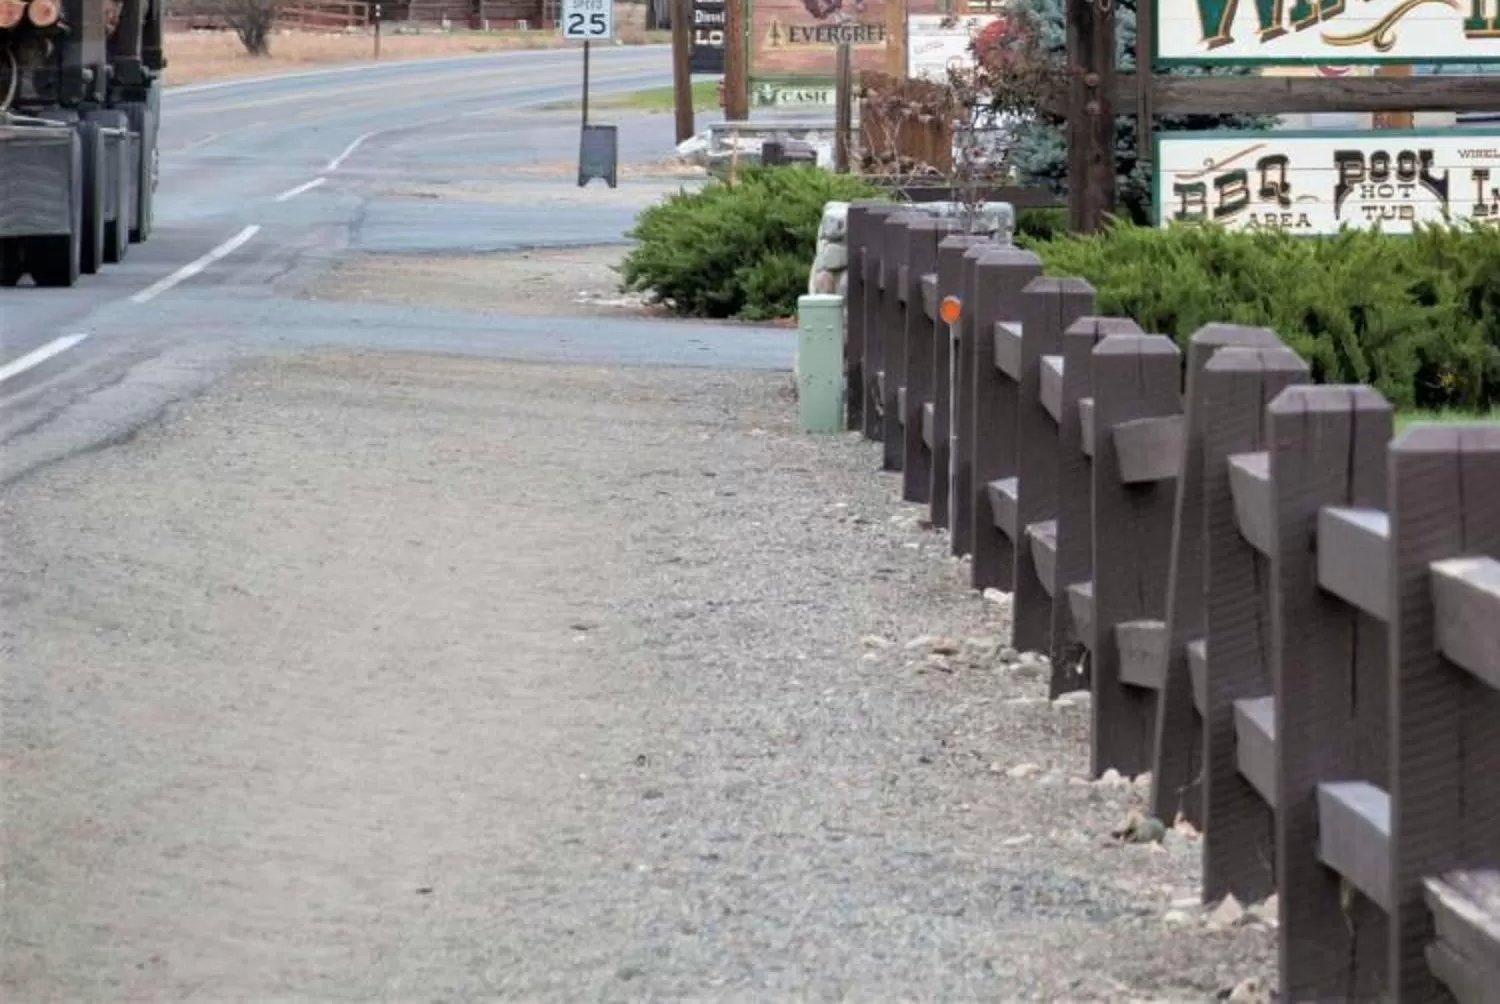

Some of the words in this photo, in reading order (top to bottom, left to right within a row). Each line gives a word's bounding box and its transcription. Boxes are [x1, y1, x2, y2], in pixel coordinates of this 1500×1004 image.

[567, 13, 606, 35] 25
[1173, 154, 1292, 221] BBQ
[1333, 149, 1451, 222] POOL
[1360, 183, 1416, 199] HOT
[1246, 213, 1313, 228] AREA
[1361, 205, 1414, 220] TUB
